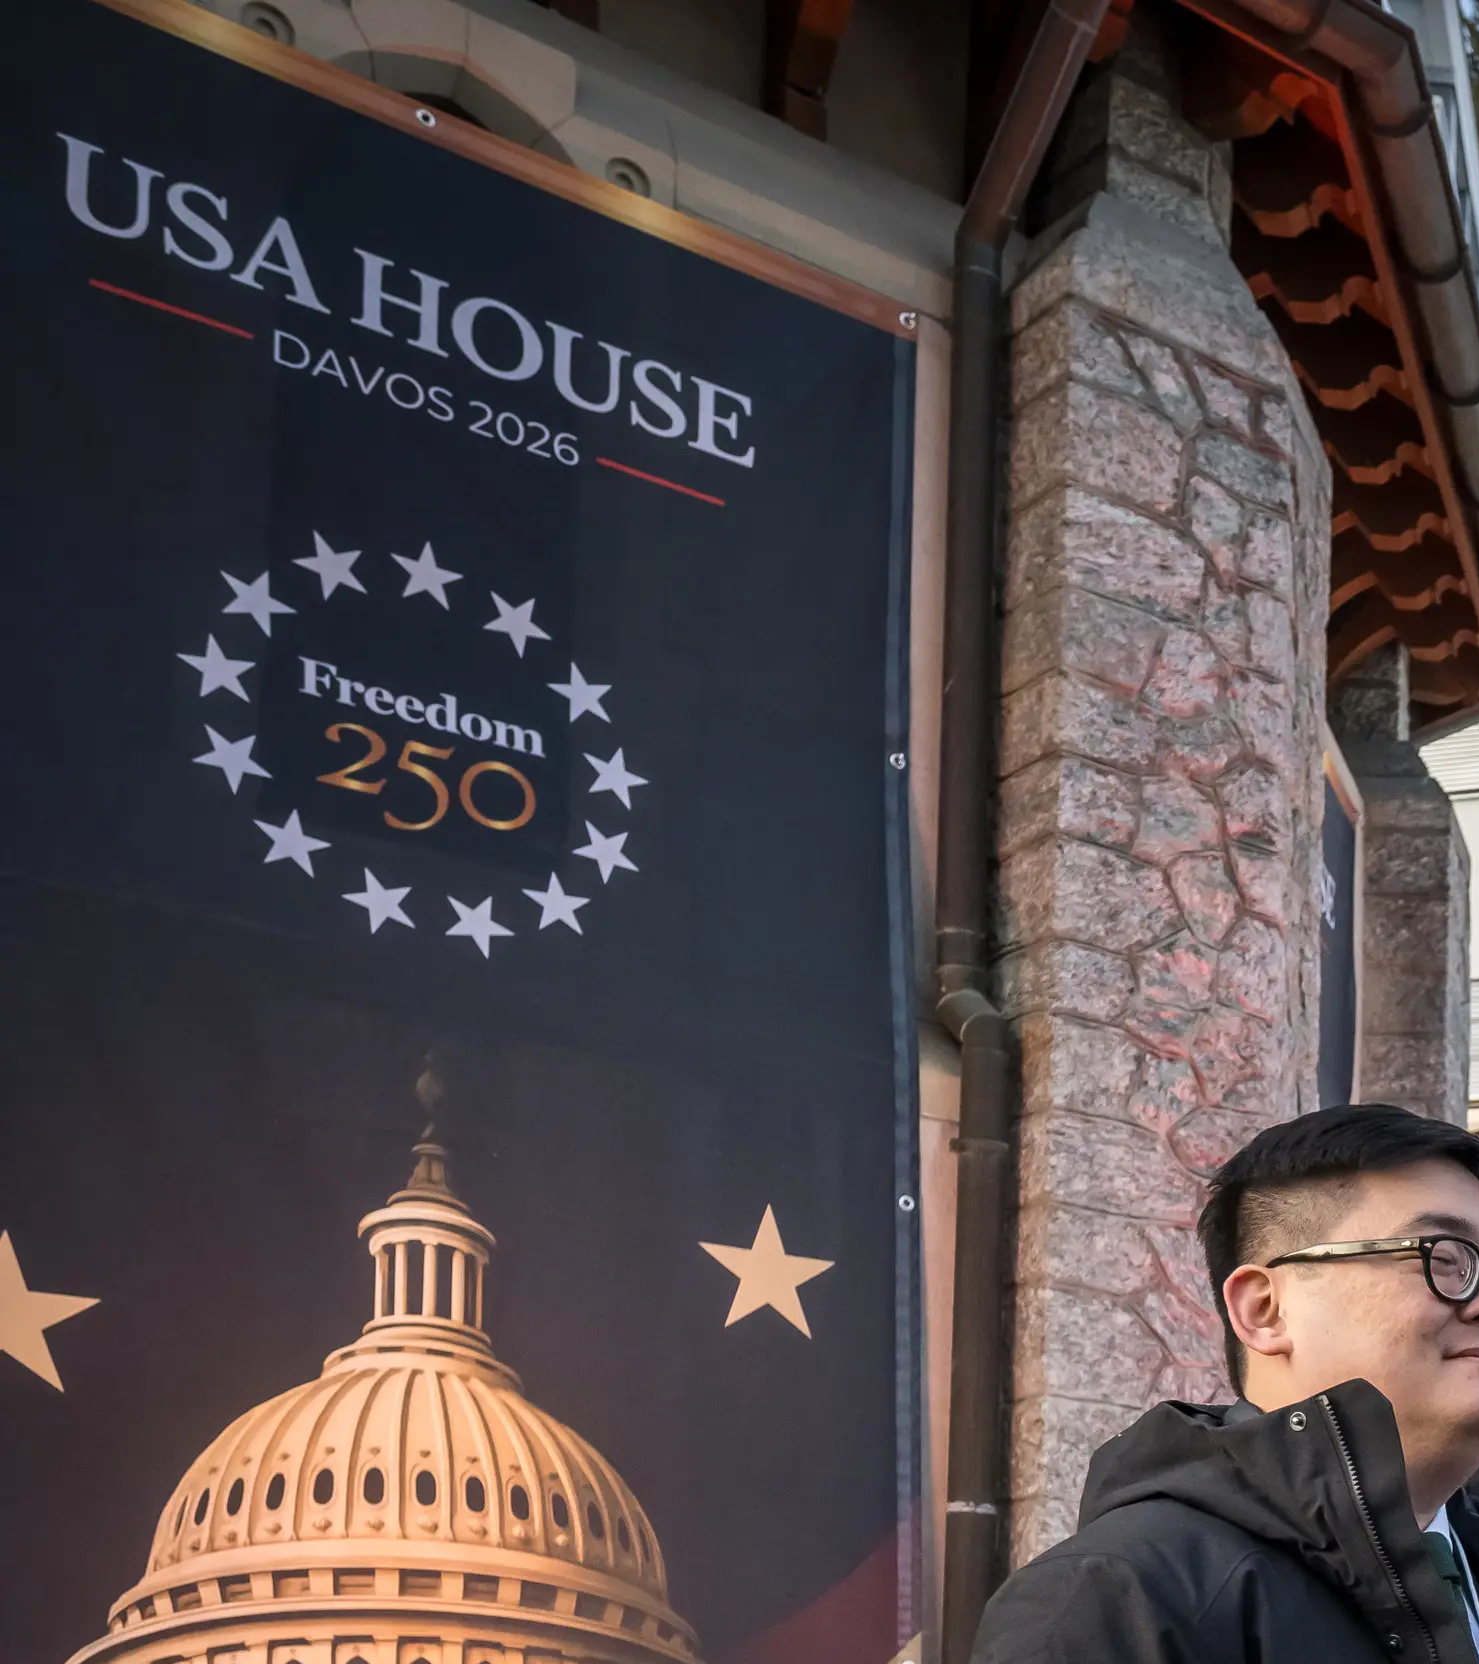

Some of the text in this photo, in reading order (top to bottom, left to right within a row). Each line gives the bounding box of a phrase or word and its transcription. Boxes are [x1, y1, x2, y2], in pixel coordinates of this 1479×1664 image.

[55, 131, 757, 470] USA HOUSE
[272, 328, 581, 467] DAVOS 2026
[297, 654, 547, 759] Freedom
[316, 722, 537, 832] 250
